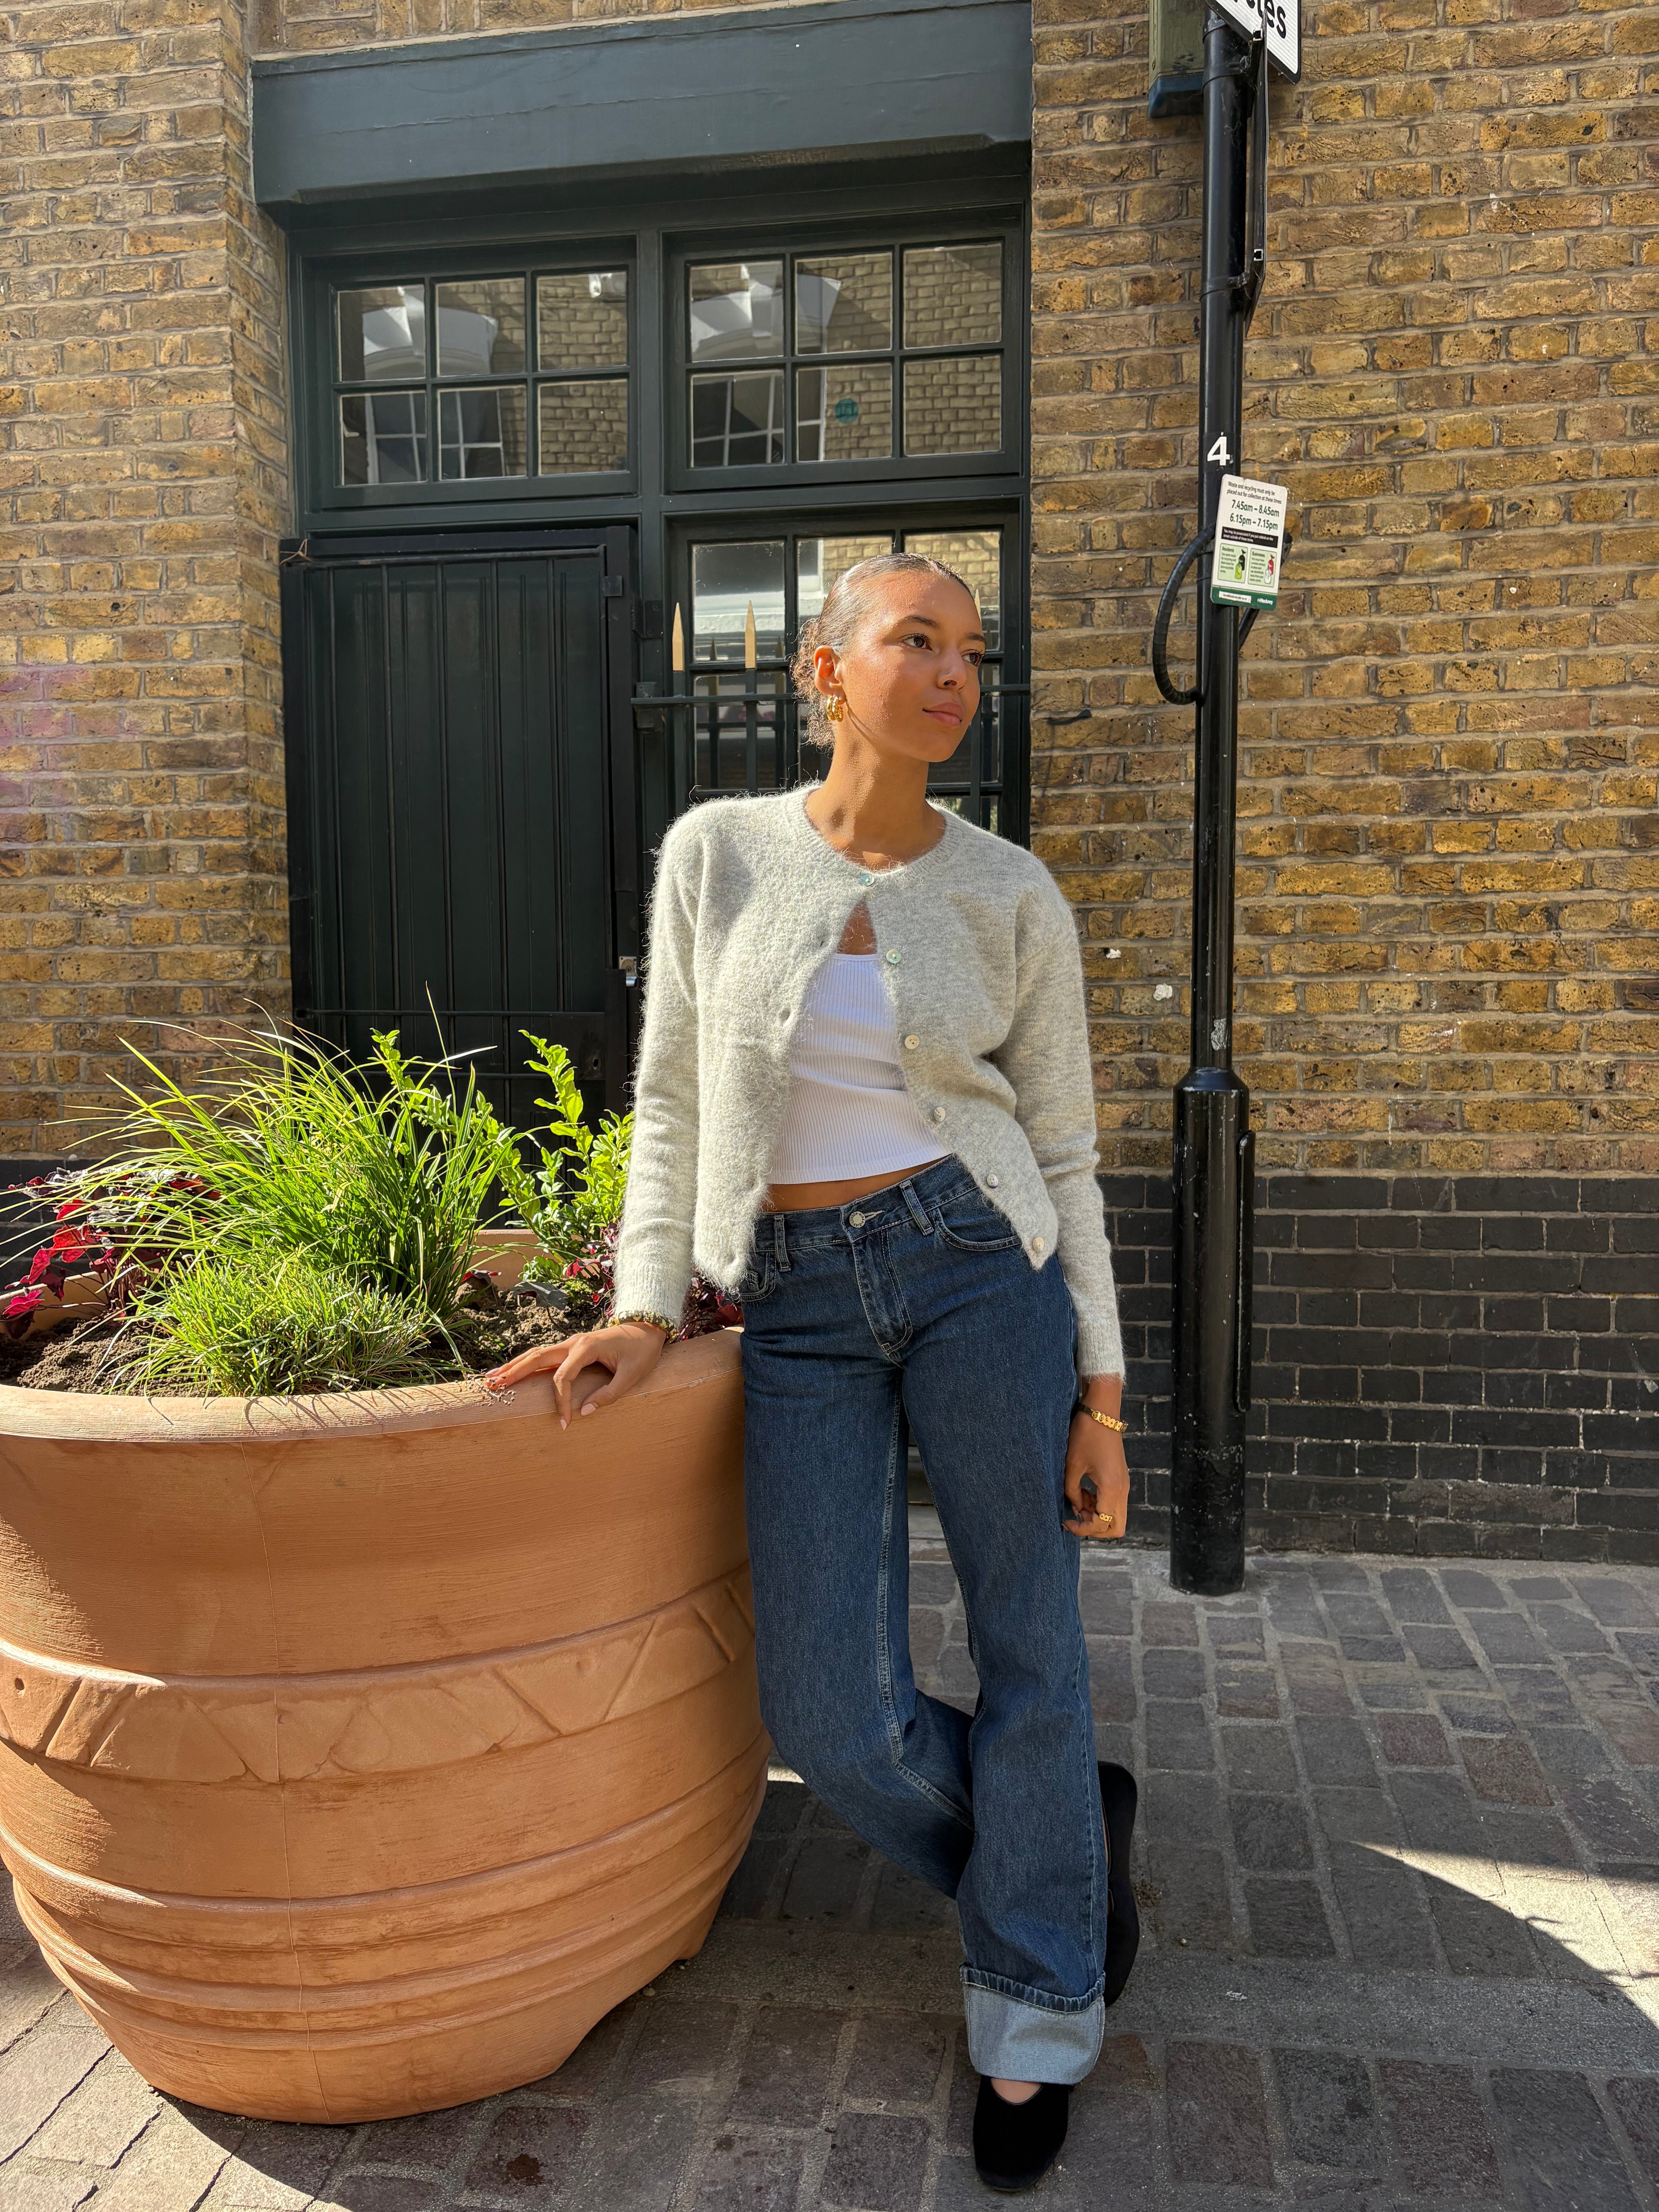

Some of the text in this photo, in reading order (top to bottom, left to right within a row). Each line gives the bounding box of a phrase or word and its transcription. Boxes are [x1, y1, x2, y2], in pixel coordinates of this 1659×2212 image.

[1208, 436, 1230, 466] 4
[1231, 499, 1252, 512] 7.45am
[1259, 505, 1279, 517] 8.45am
[1230, 512, 1251, 526] 6.15pm
[1257, 518, 1278, 531] 7.15pm
